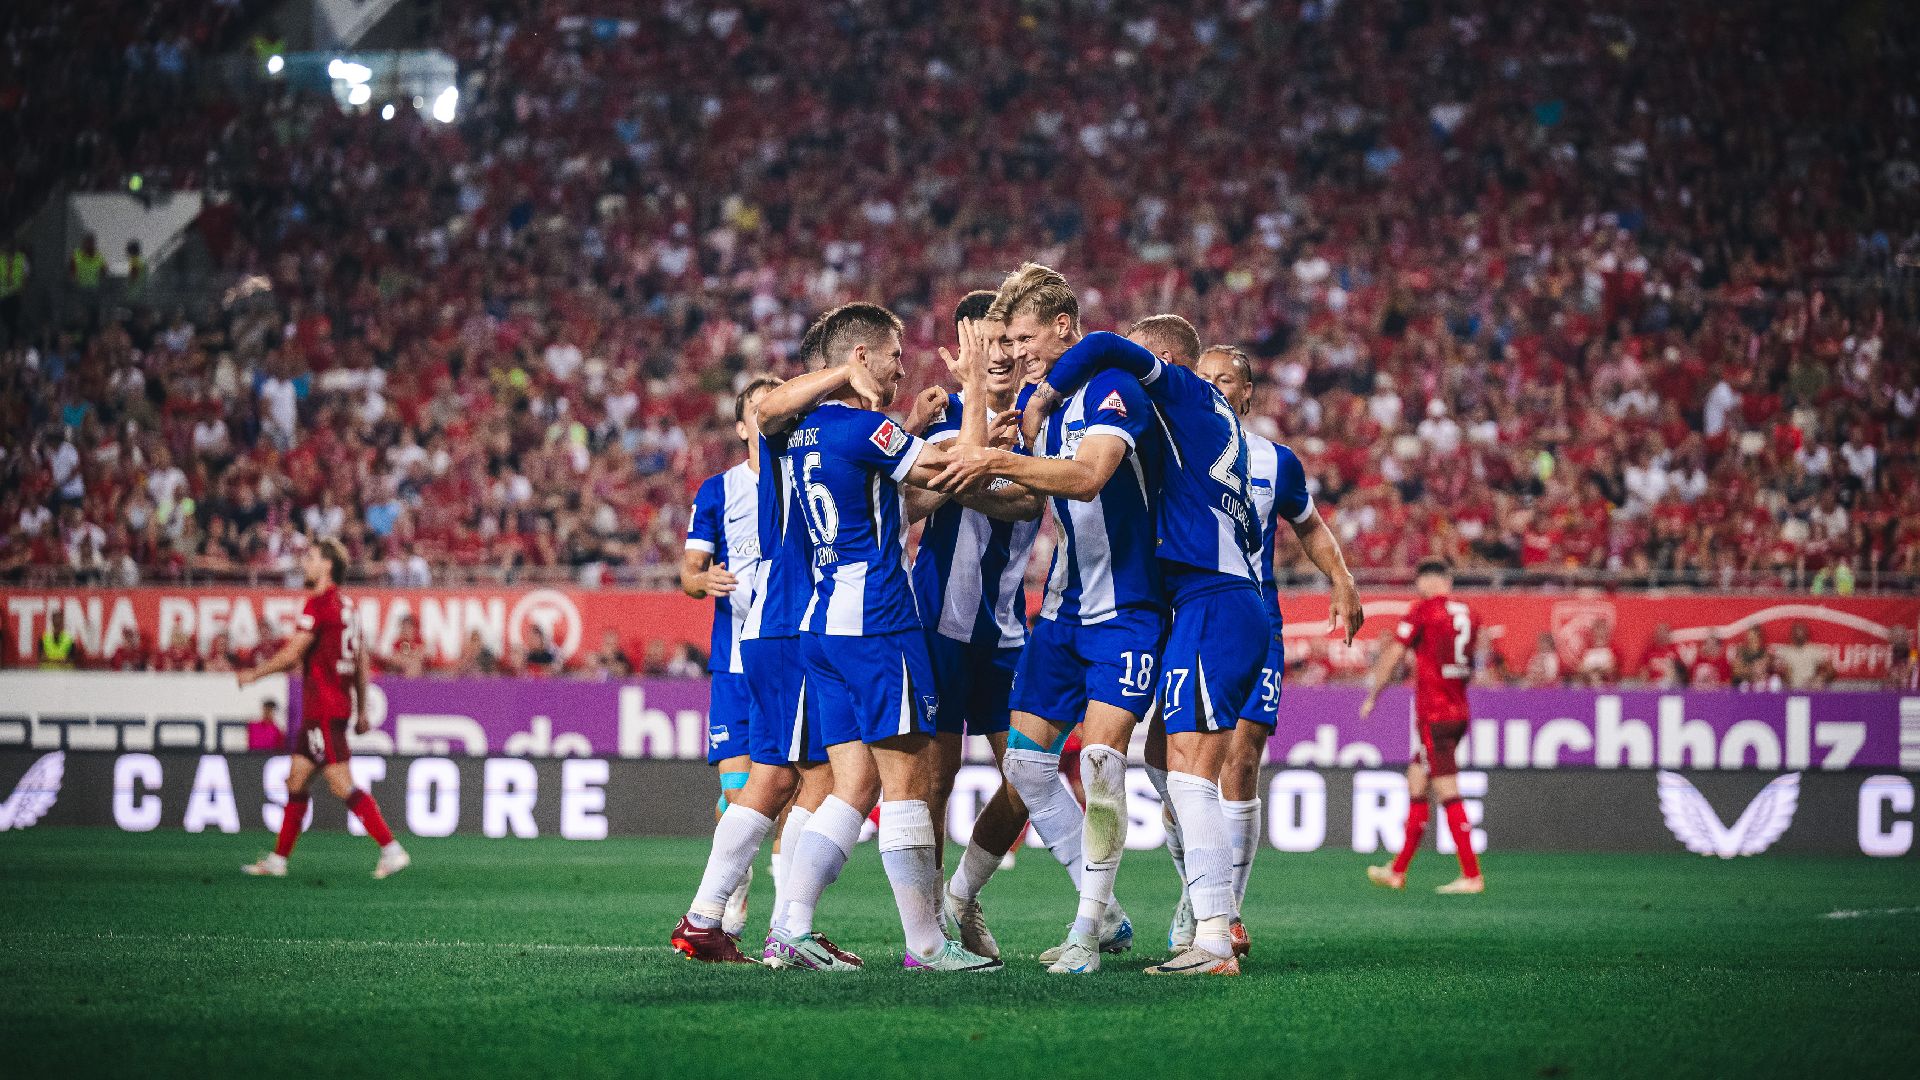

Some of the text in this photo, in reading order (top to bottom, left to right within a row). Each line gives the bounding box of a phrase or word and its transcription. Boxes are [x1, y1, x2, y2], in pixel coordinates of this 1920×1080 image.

[804, 427, 820, 446] BSC
[1118, 651, 1154, 691] 18
[1261, 667, 1282, 705] 39
